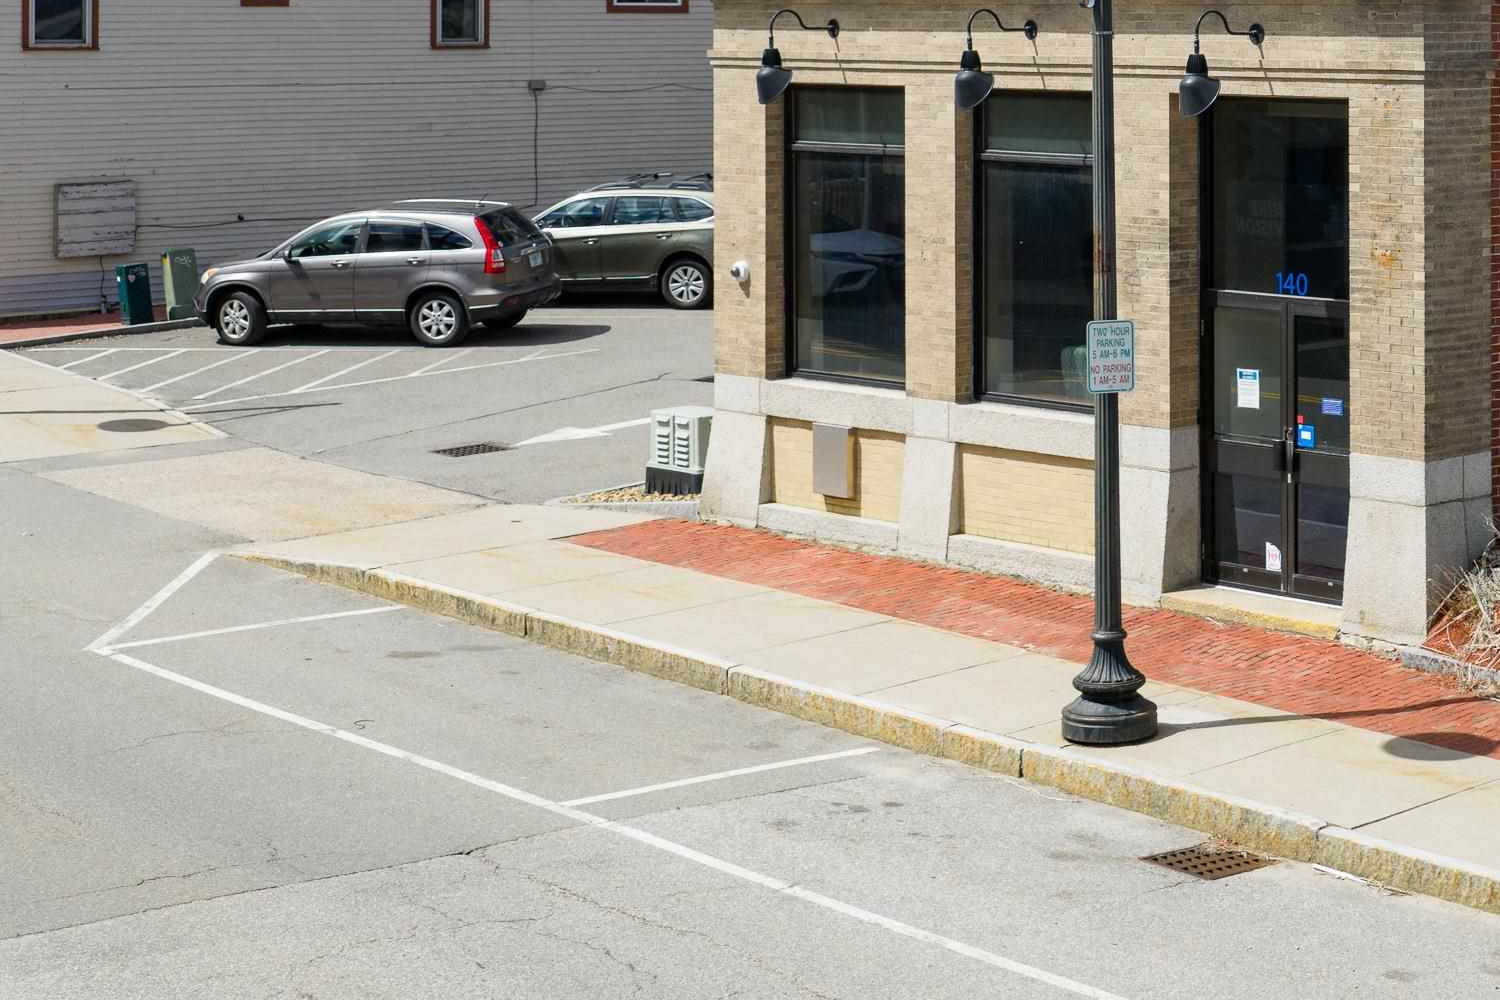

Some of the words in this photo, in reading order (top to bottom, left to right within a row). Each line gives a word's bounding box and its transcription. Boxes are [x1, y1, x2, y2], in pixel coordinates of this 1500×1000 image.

[1275, 272, 1308, 296] 140
[1093, 328, 1107, 336] TWO
[1110, 326, 1130, 336] HOUR
[1096, 338, 1126, 347] PARKING
[1120, 348, 1131, 357] PM
[1091, 365, 1100, 374] NO
[1103, 364, 1132, 373] PARKING
[1119, 374, 1130, 384] AM
